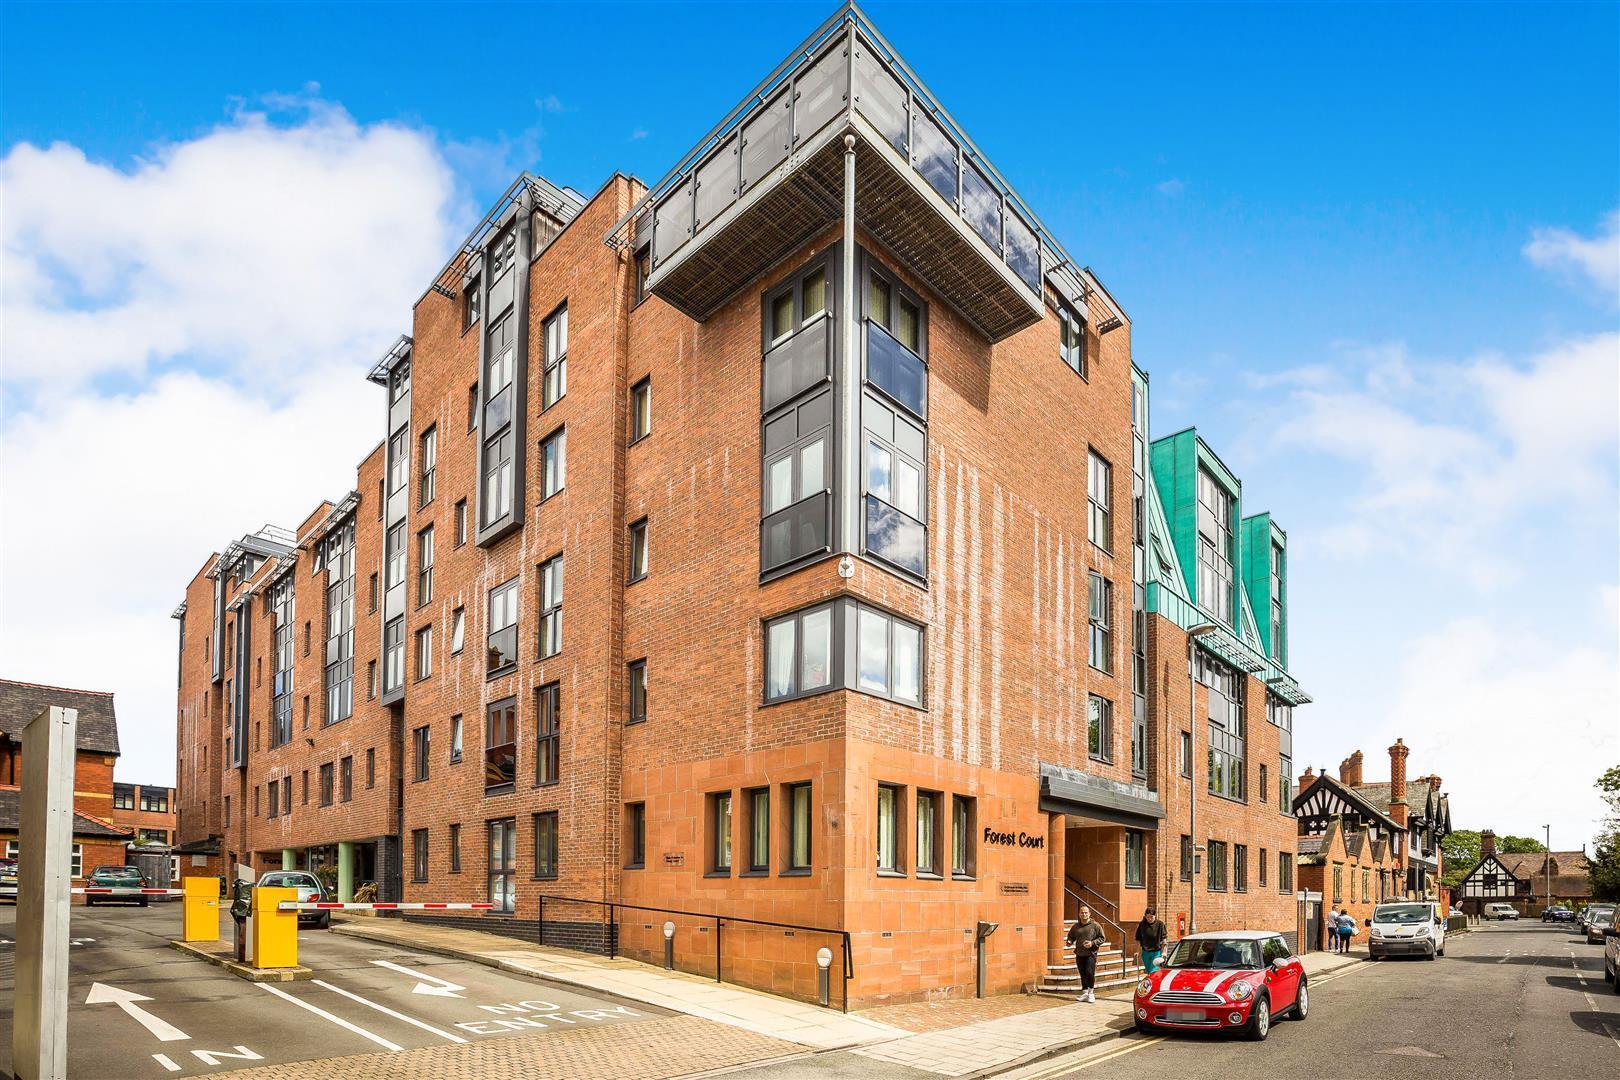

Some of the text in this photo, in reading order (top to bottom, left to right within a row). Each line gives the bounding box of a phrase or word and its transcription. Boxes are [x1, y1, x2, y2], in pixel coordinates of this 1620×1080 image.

[984, 828, 1044, 848] Forest Court
[476, 1000, 561, 1015] NO
[454, 1006, 642, 1034] ENTRY
[151, 1045, 265, 1072] IN
